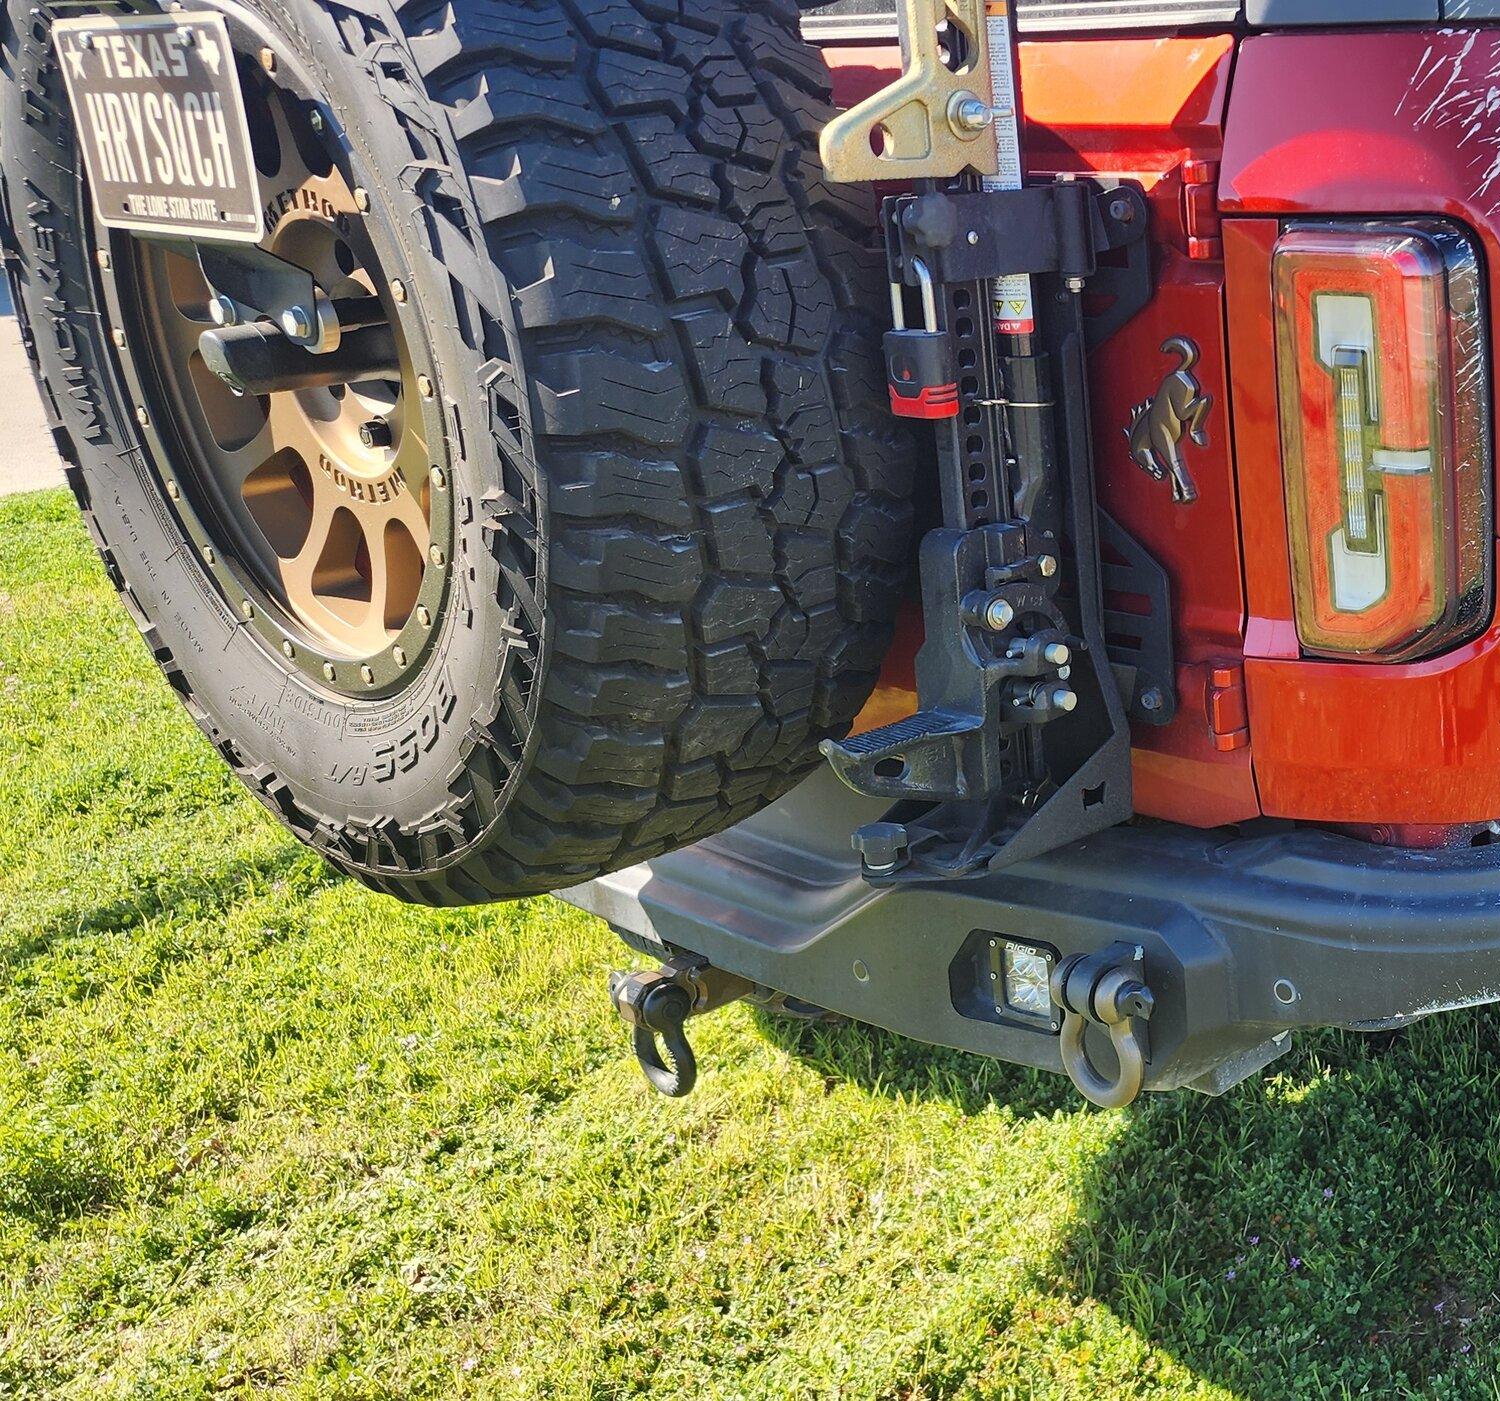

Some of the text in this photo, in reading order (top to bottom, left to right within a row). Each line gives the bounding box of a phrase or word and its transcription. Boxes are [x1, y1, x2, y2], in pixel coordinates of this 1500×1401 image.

[92, 33, 189, 79] TEXAS
[128, 194, 218, 221] THE LONE STAR STATE
[1005, 941, 1037, 955] RIGID
